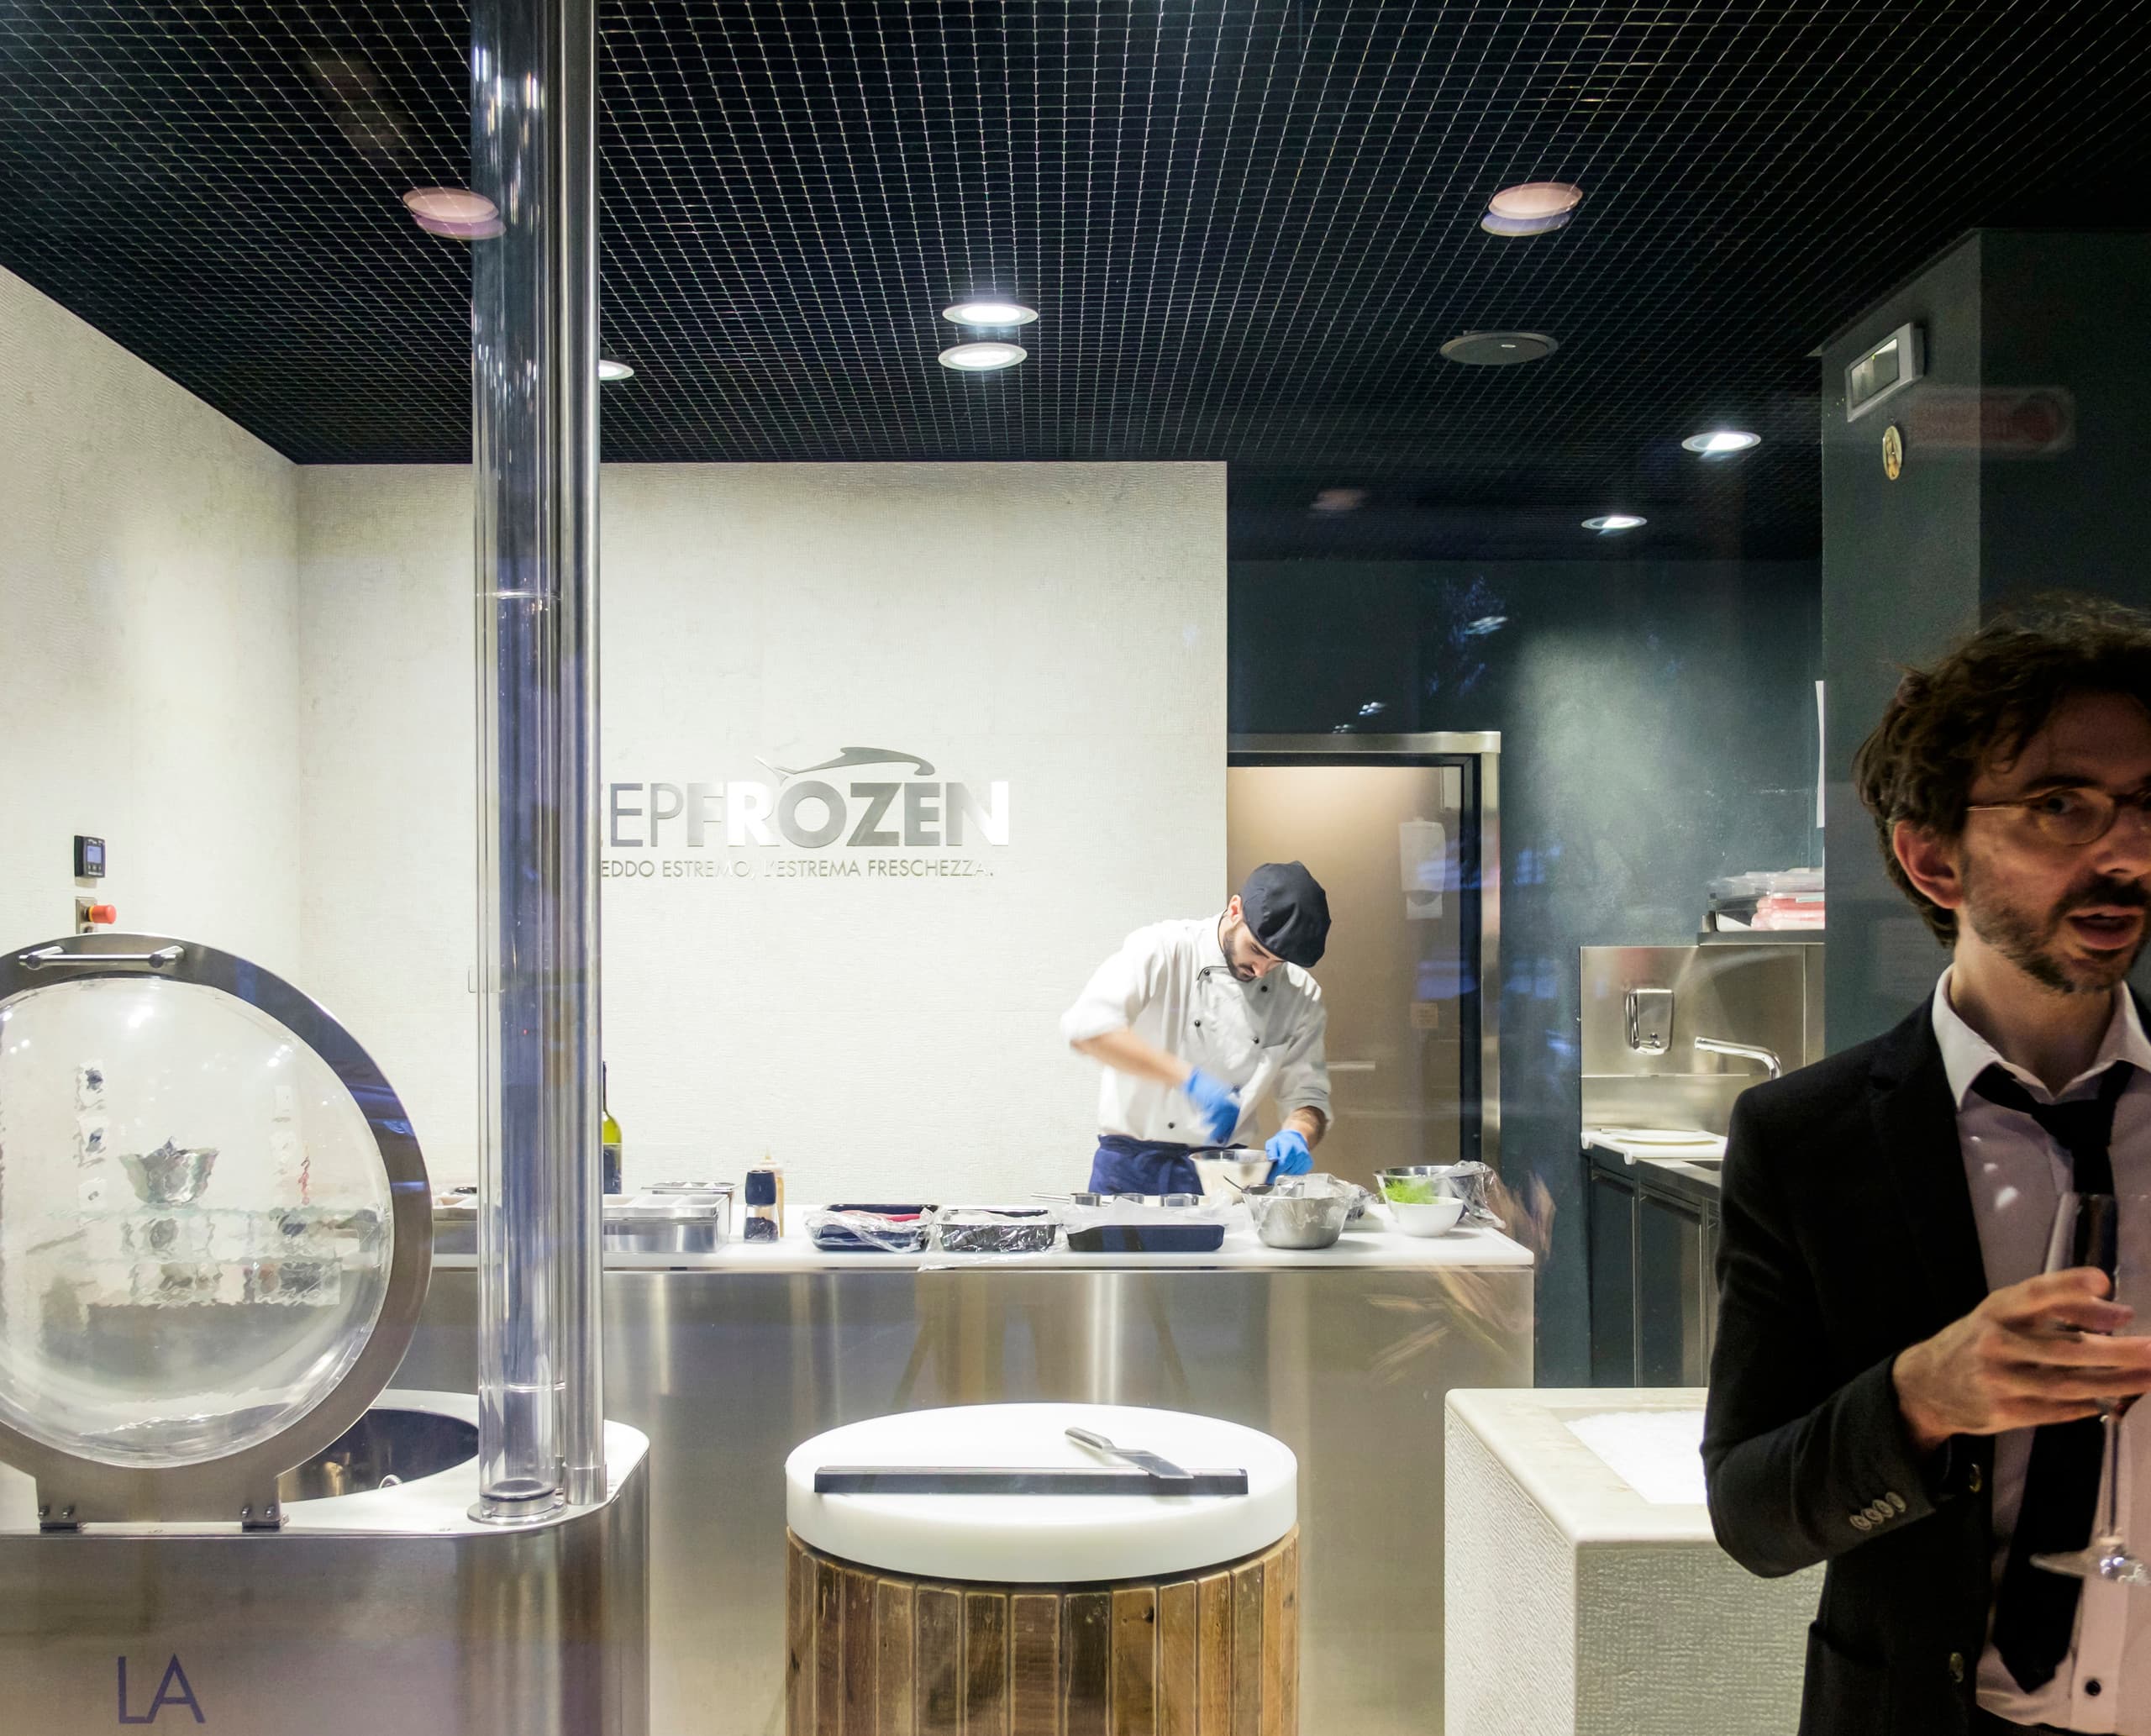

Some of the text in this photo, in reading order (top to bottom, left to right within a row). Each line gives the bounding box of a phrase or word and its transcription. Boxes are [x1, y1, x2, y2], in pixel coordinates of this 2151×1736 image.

[602, 781, 1009, 848] EPFROZEN
[601, 859, 994, 880] EDDO ESTREMO, L'ESTREMA FRESCHEZZA.
[118, 1652, 207, 1723] LA
